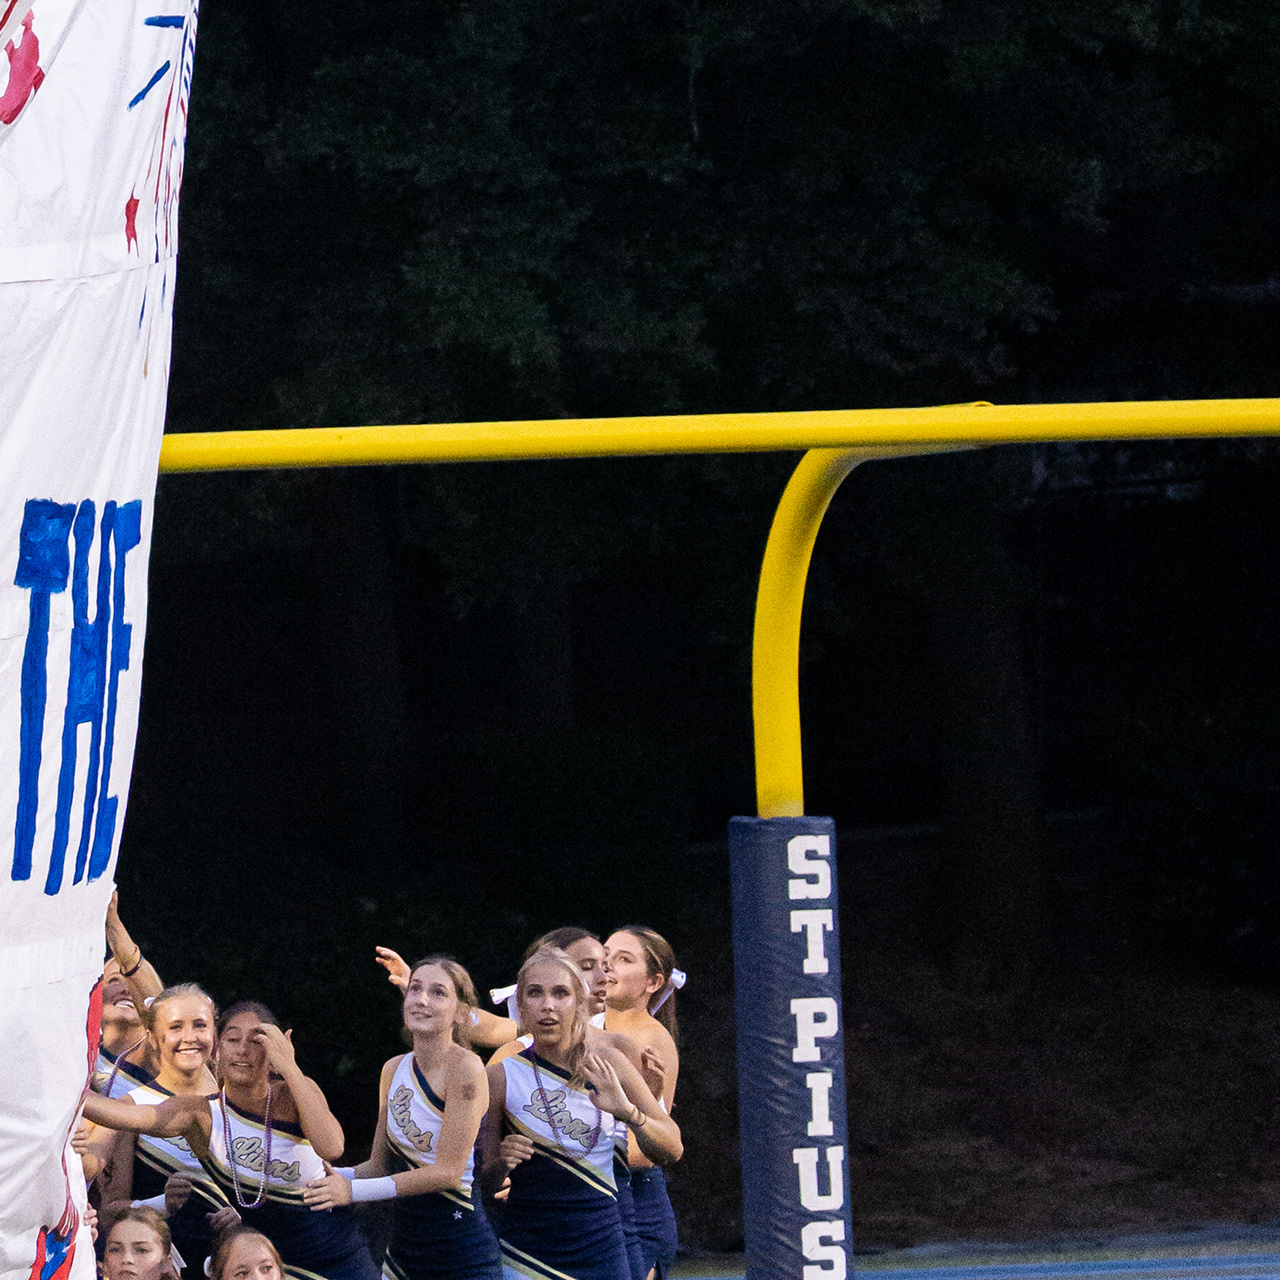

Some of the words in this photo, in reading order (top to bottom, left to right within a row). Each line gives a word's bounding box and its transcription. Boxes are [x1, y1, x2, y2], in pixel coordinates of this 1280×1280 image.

[12, 500, 141, 895] THE
[787, 834, 834, 975] ST
[391, 1084, 433, 1153] Lions
[523, 1088, 598, 1149] Lions
[230, 1136, 302, 1183] Lions
